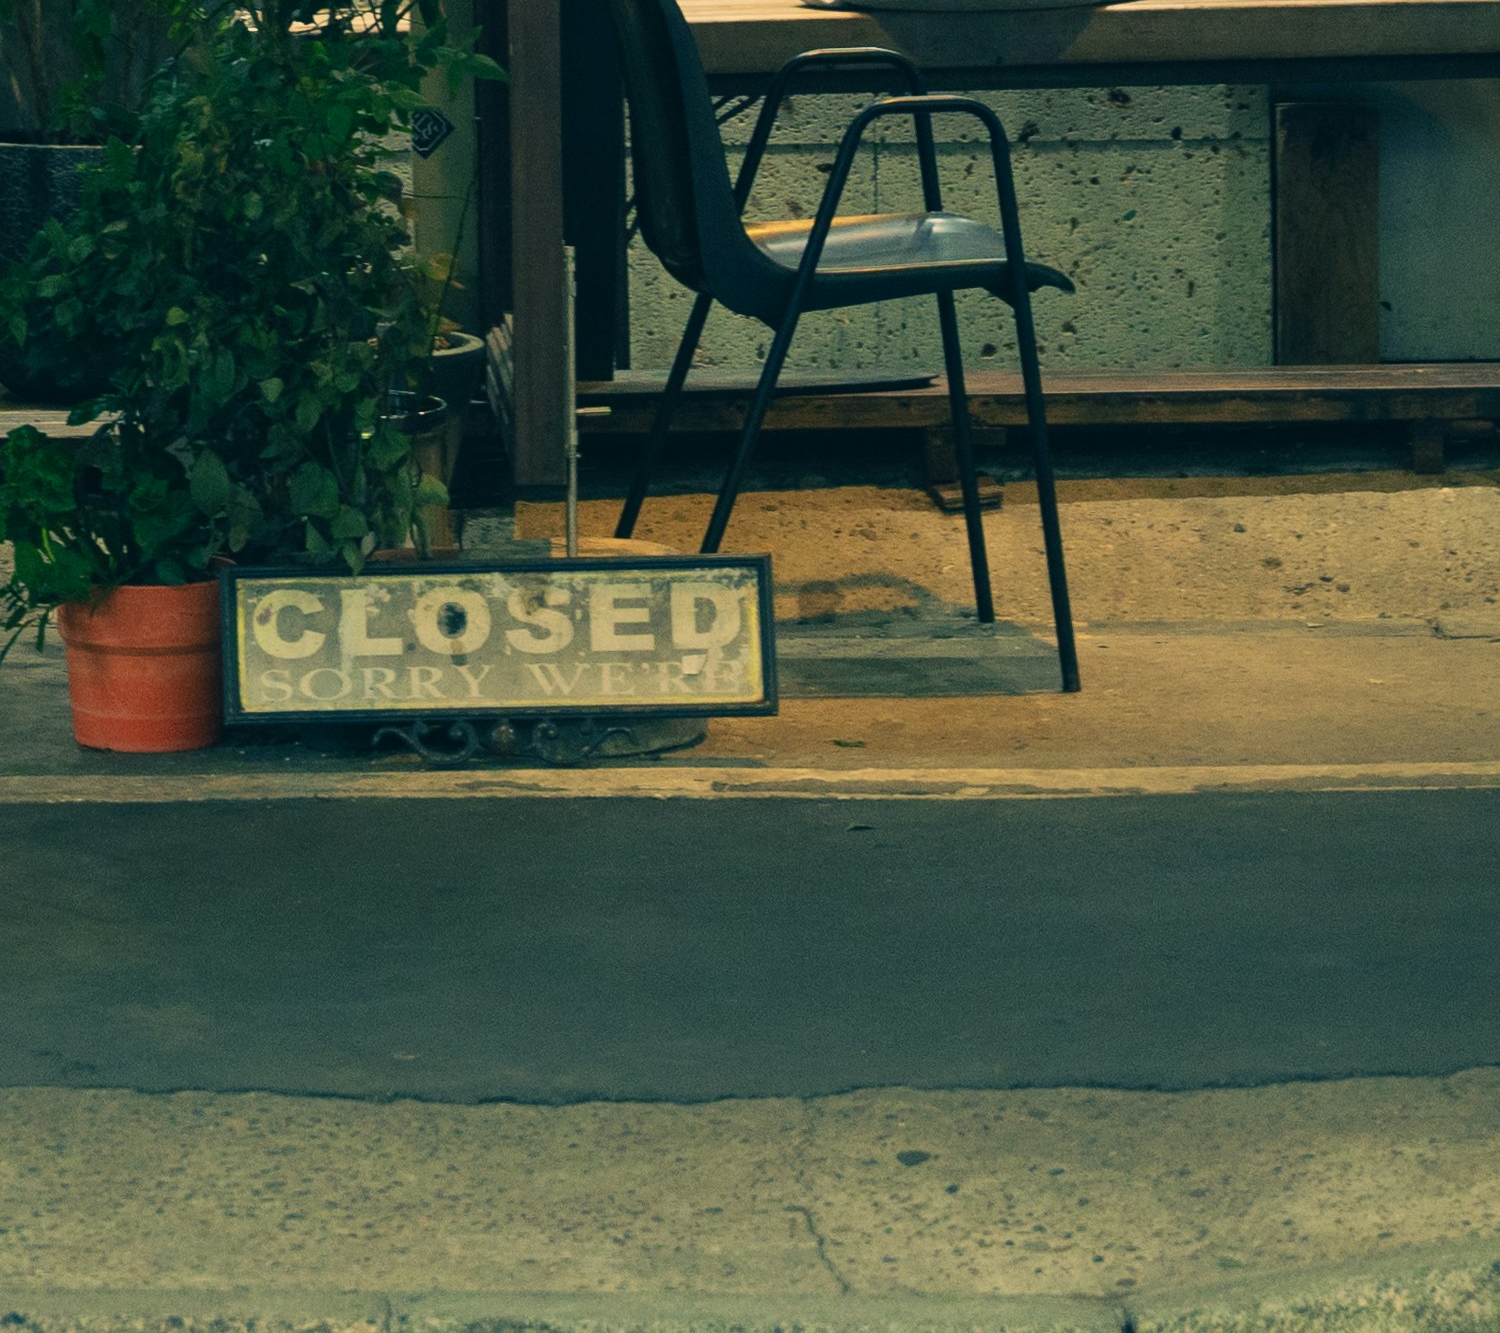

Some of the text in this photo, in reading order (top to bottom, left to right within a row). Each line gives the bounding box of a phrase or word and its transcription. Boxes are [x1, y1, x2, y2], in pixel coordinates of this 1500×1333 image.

[252, 580, 747, 659] CLOSED
[260, 658, 745, 704] SORRY WE'RE
